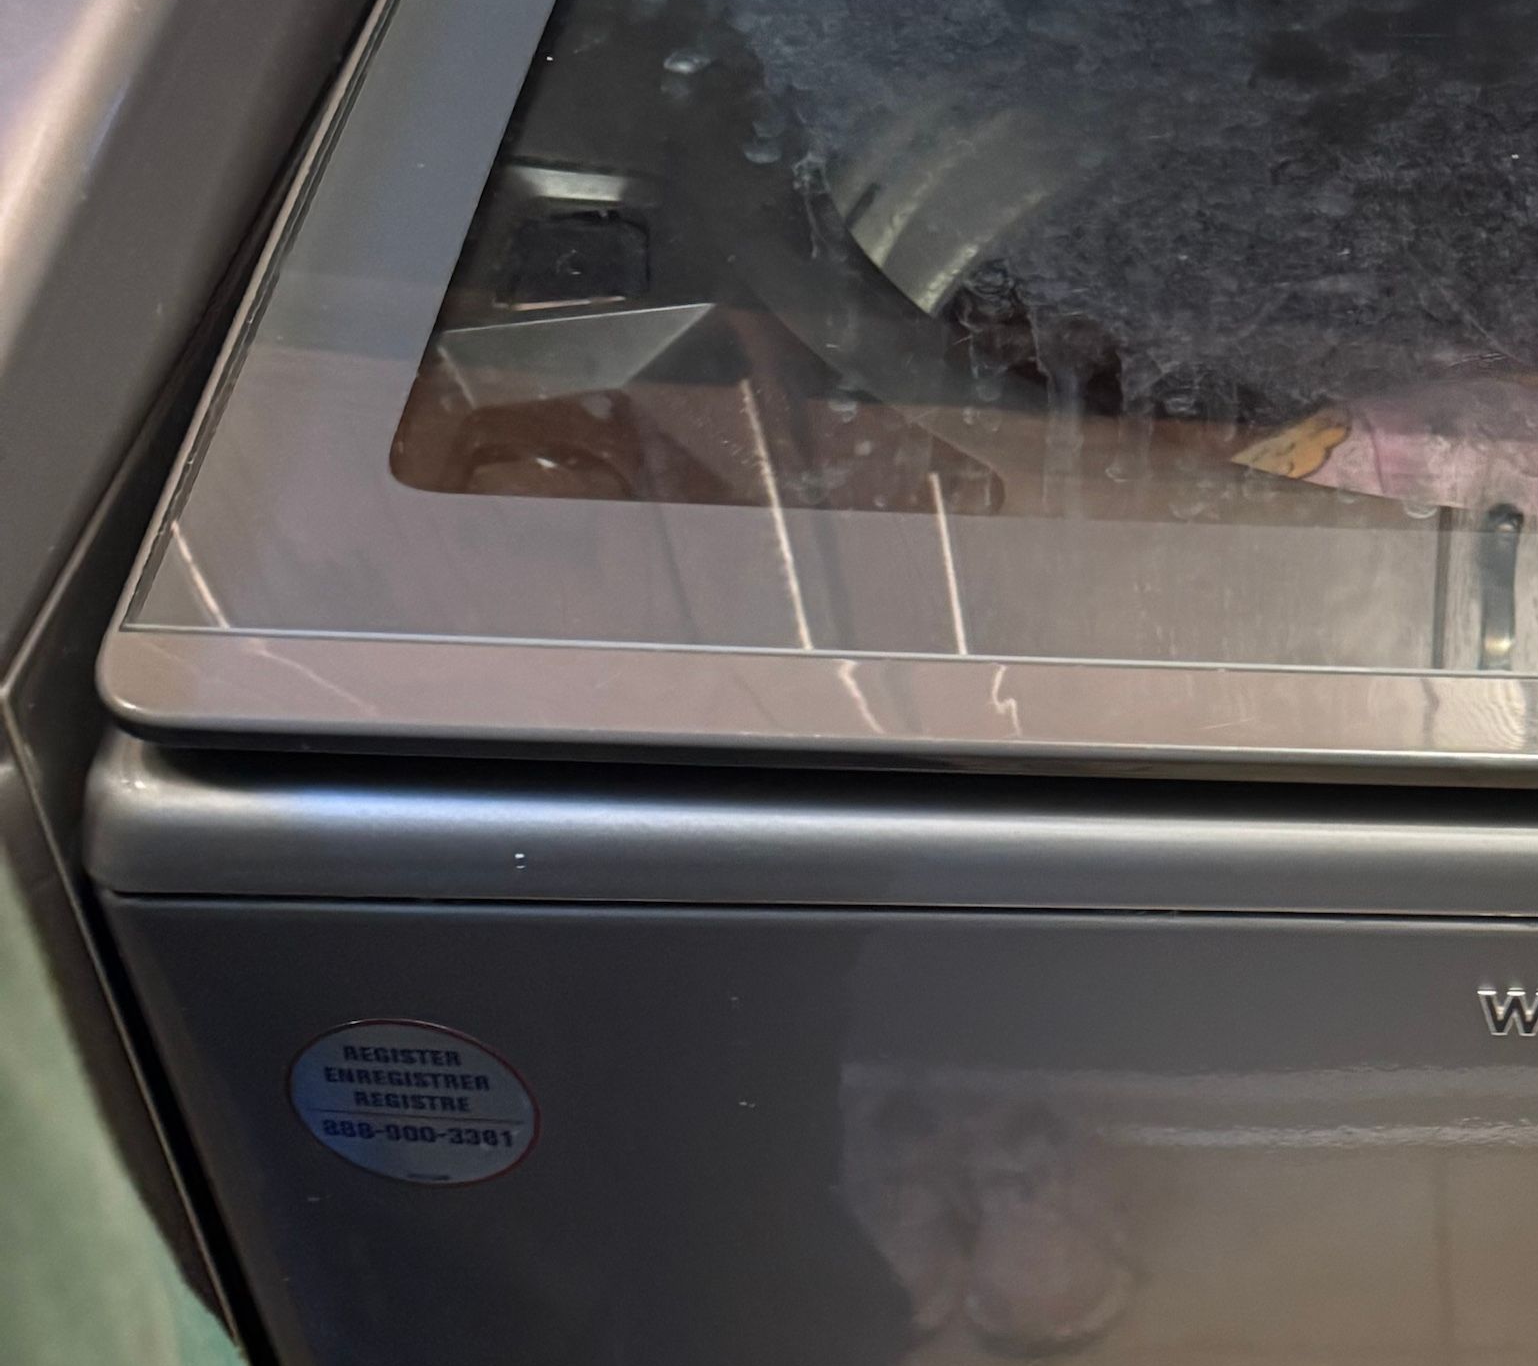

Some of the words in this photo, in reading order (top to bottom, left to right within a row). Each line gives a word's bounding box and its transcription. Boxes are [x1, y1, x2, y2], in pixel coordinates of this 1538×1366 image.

[343, 1045, 462, 1067] REGISTER
[324, 1066, 491, 1091] ENREGISTRER
[354, 1091, 470, 1113] REGISTRE
